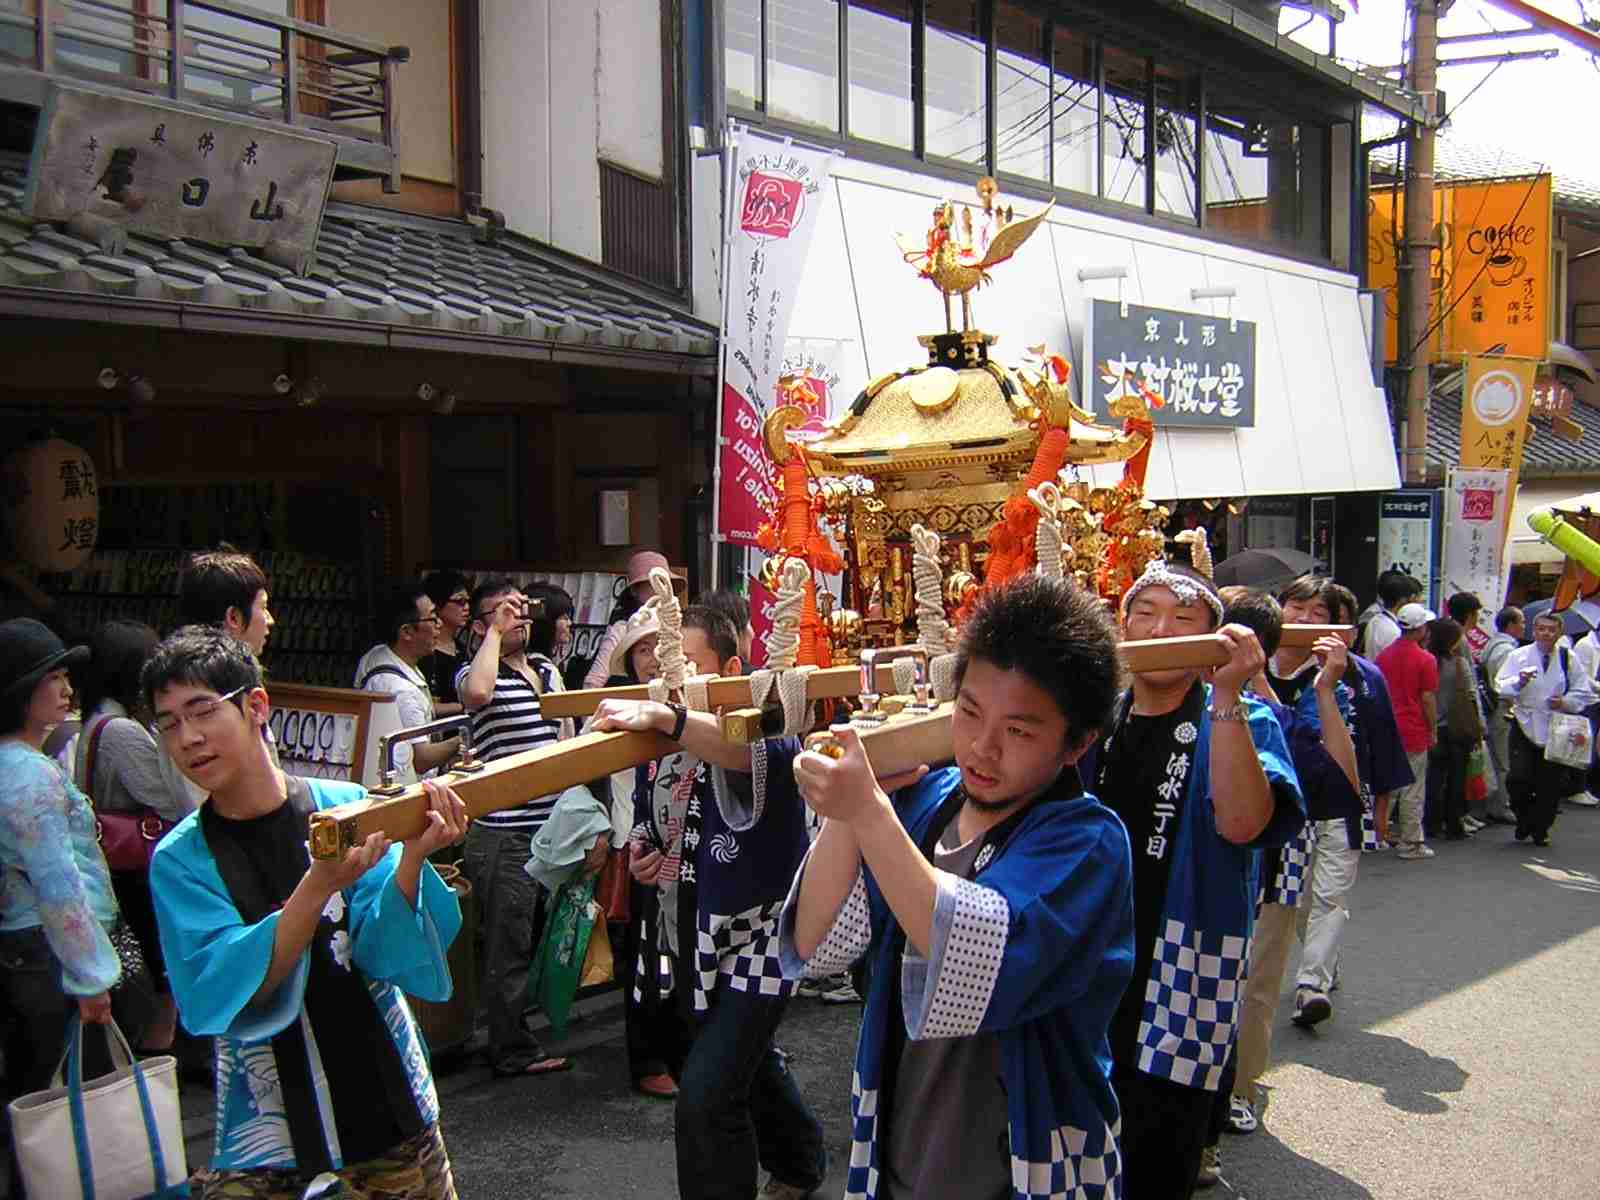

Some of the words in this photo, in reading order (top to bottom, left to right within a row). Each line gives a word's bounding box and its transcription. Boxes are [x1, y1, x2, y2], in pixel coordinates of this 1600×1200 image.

[1144, 316, 1217, 346] 京人形
[1146, 752, 1190, 860] 清水二丁目
